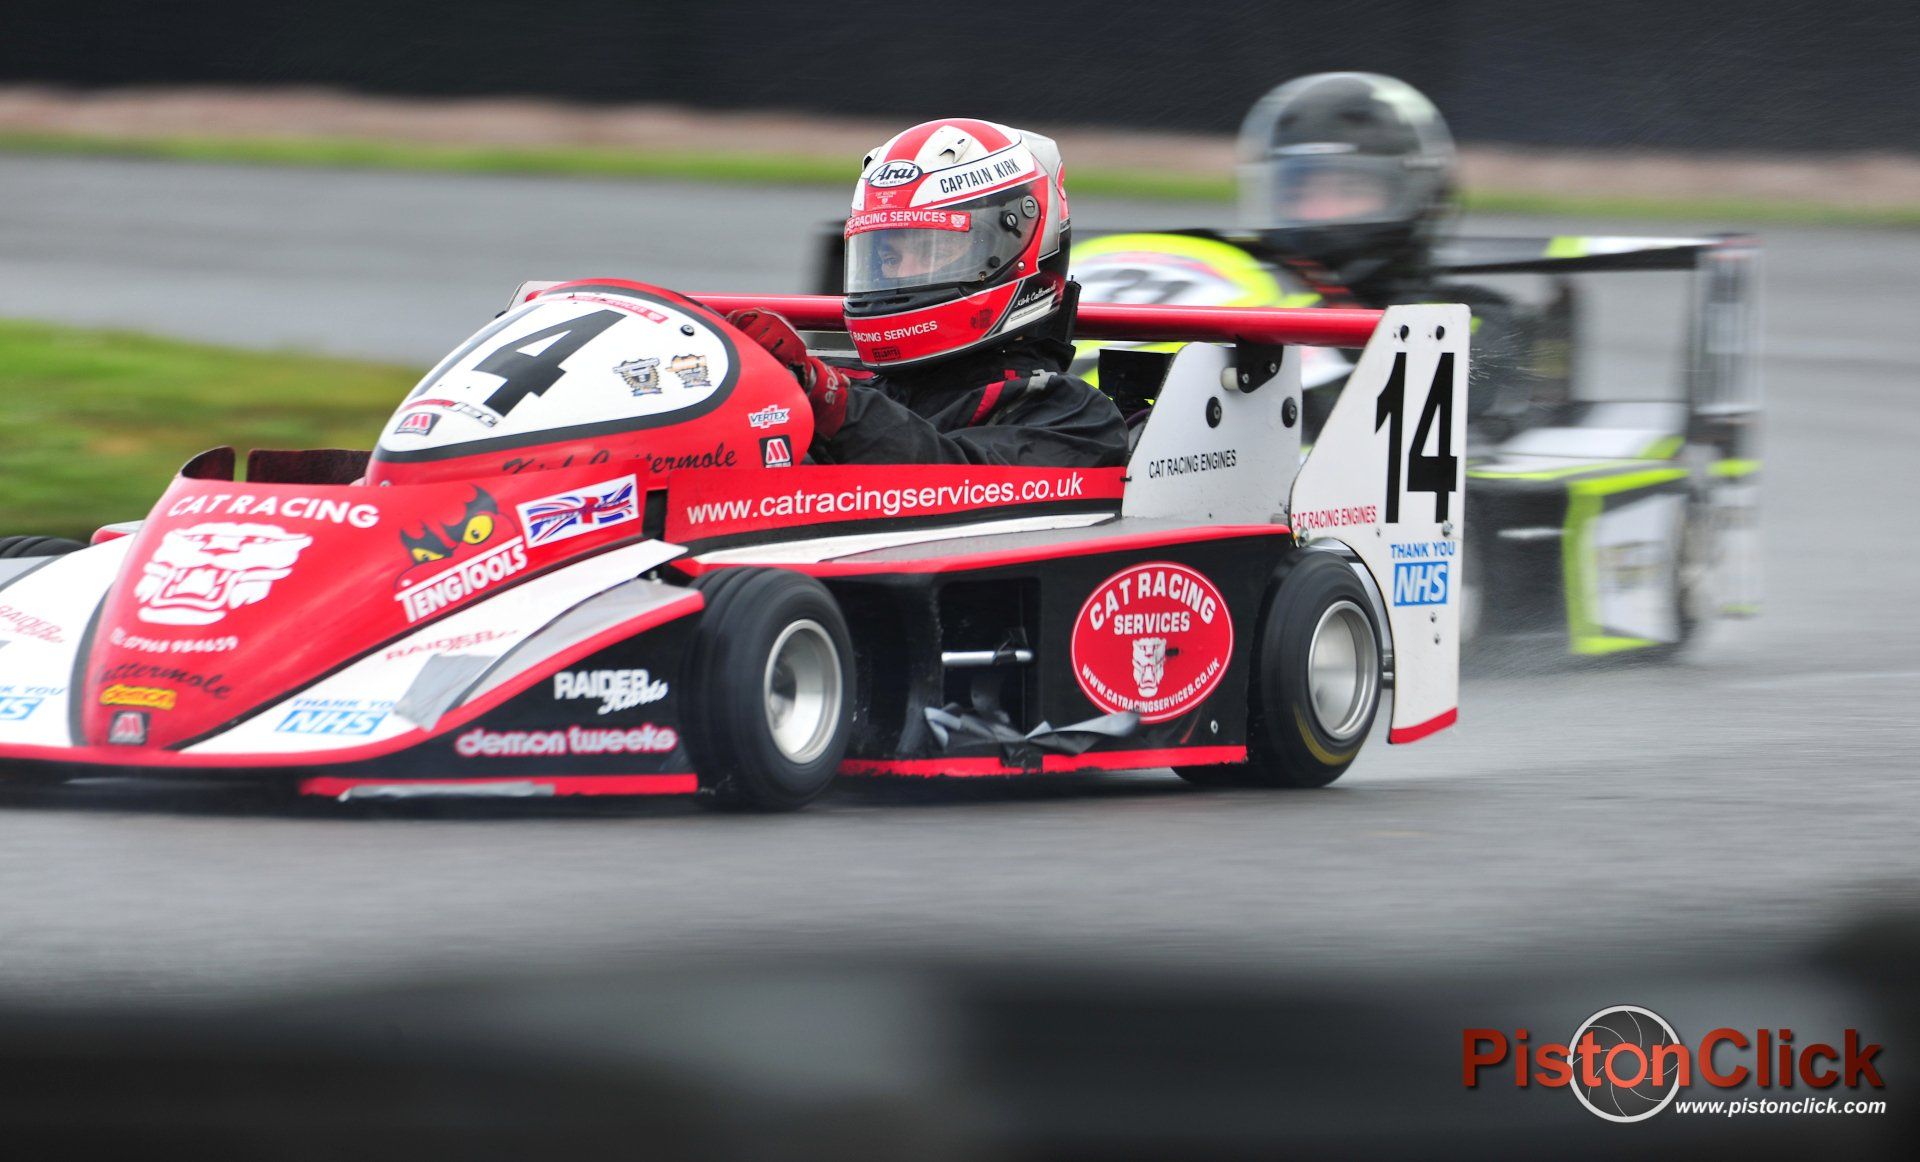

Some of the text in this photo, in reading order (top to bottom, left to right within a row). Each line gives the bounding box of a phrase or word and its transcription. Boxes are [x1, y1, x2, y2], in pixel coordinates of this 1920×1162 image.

[875, 164, 917, 181] Arai
[940, 158, 1021, 194] CAPTAIN KIRK
[889, 211, 947, 224] SERVICES
[853, 329, 882, 342] RACING
[884, 320, 938, 342] SERVICES
[750, 410, 787, 424] VERTEX
[1374, 352, 1458, 524] 14
[1149, 449, 1237, 479] CAT RACING ENGINES
[167, 494, 380, 529] CAT RACING
[687, 472, 1084, 525] www.catracingservices.co.uk
[1308, 508, 1340, 530] RACING
[1342, 505, 1377, 526] ENGINES
[1390, 541, 1456, 559] THANK YOU
[1395, 563, 1448, 605] NHS
[1089, 571, 1217, 631] CAT RACING
[1113, 611, 1190, 636] SERVICES
[385, 630, 494, 661] RAIDER
[24, 685, 68, 696] YOU
[554, 668, 649, 701] RAIDER
[1082, 658, 1220, 713] WWW.CATRACINGSERVICES.CO.UK
[293, 697, 360, 709] THANK
[278, 709, 388, 736] NHS
[456, 722, 678, 757] demon tweeks
